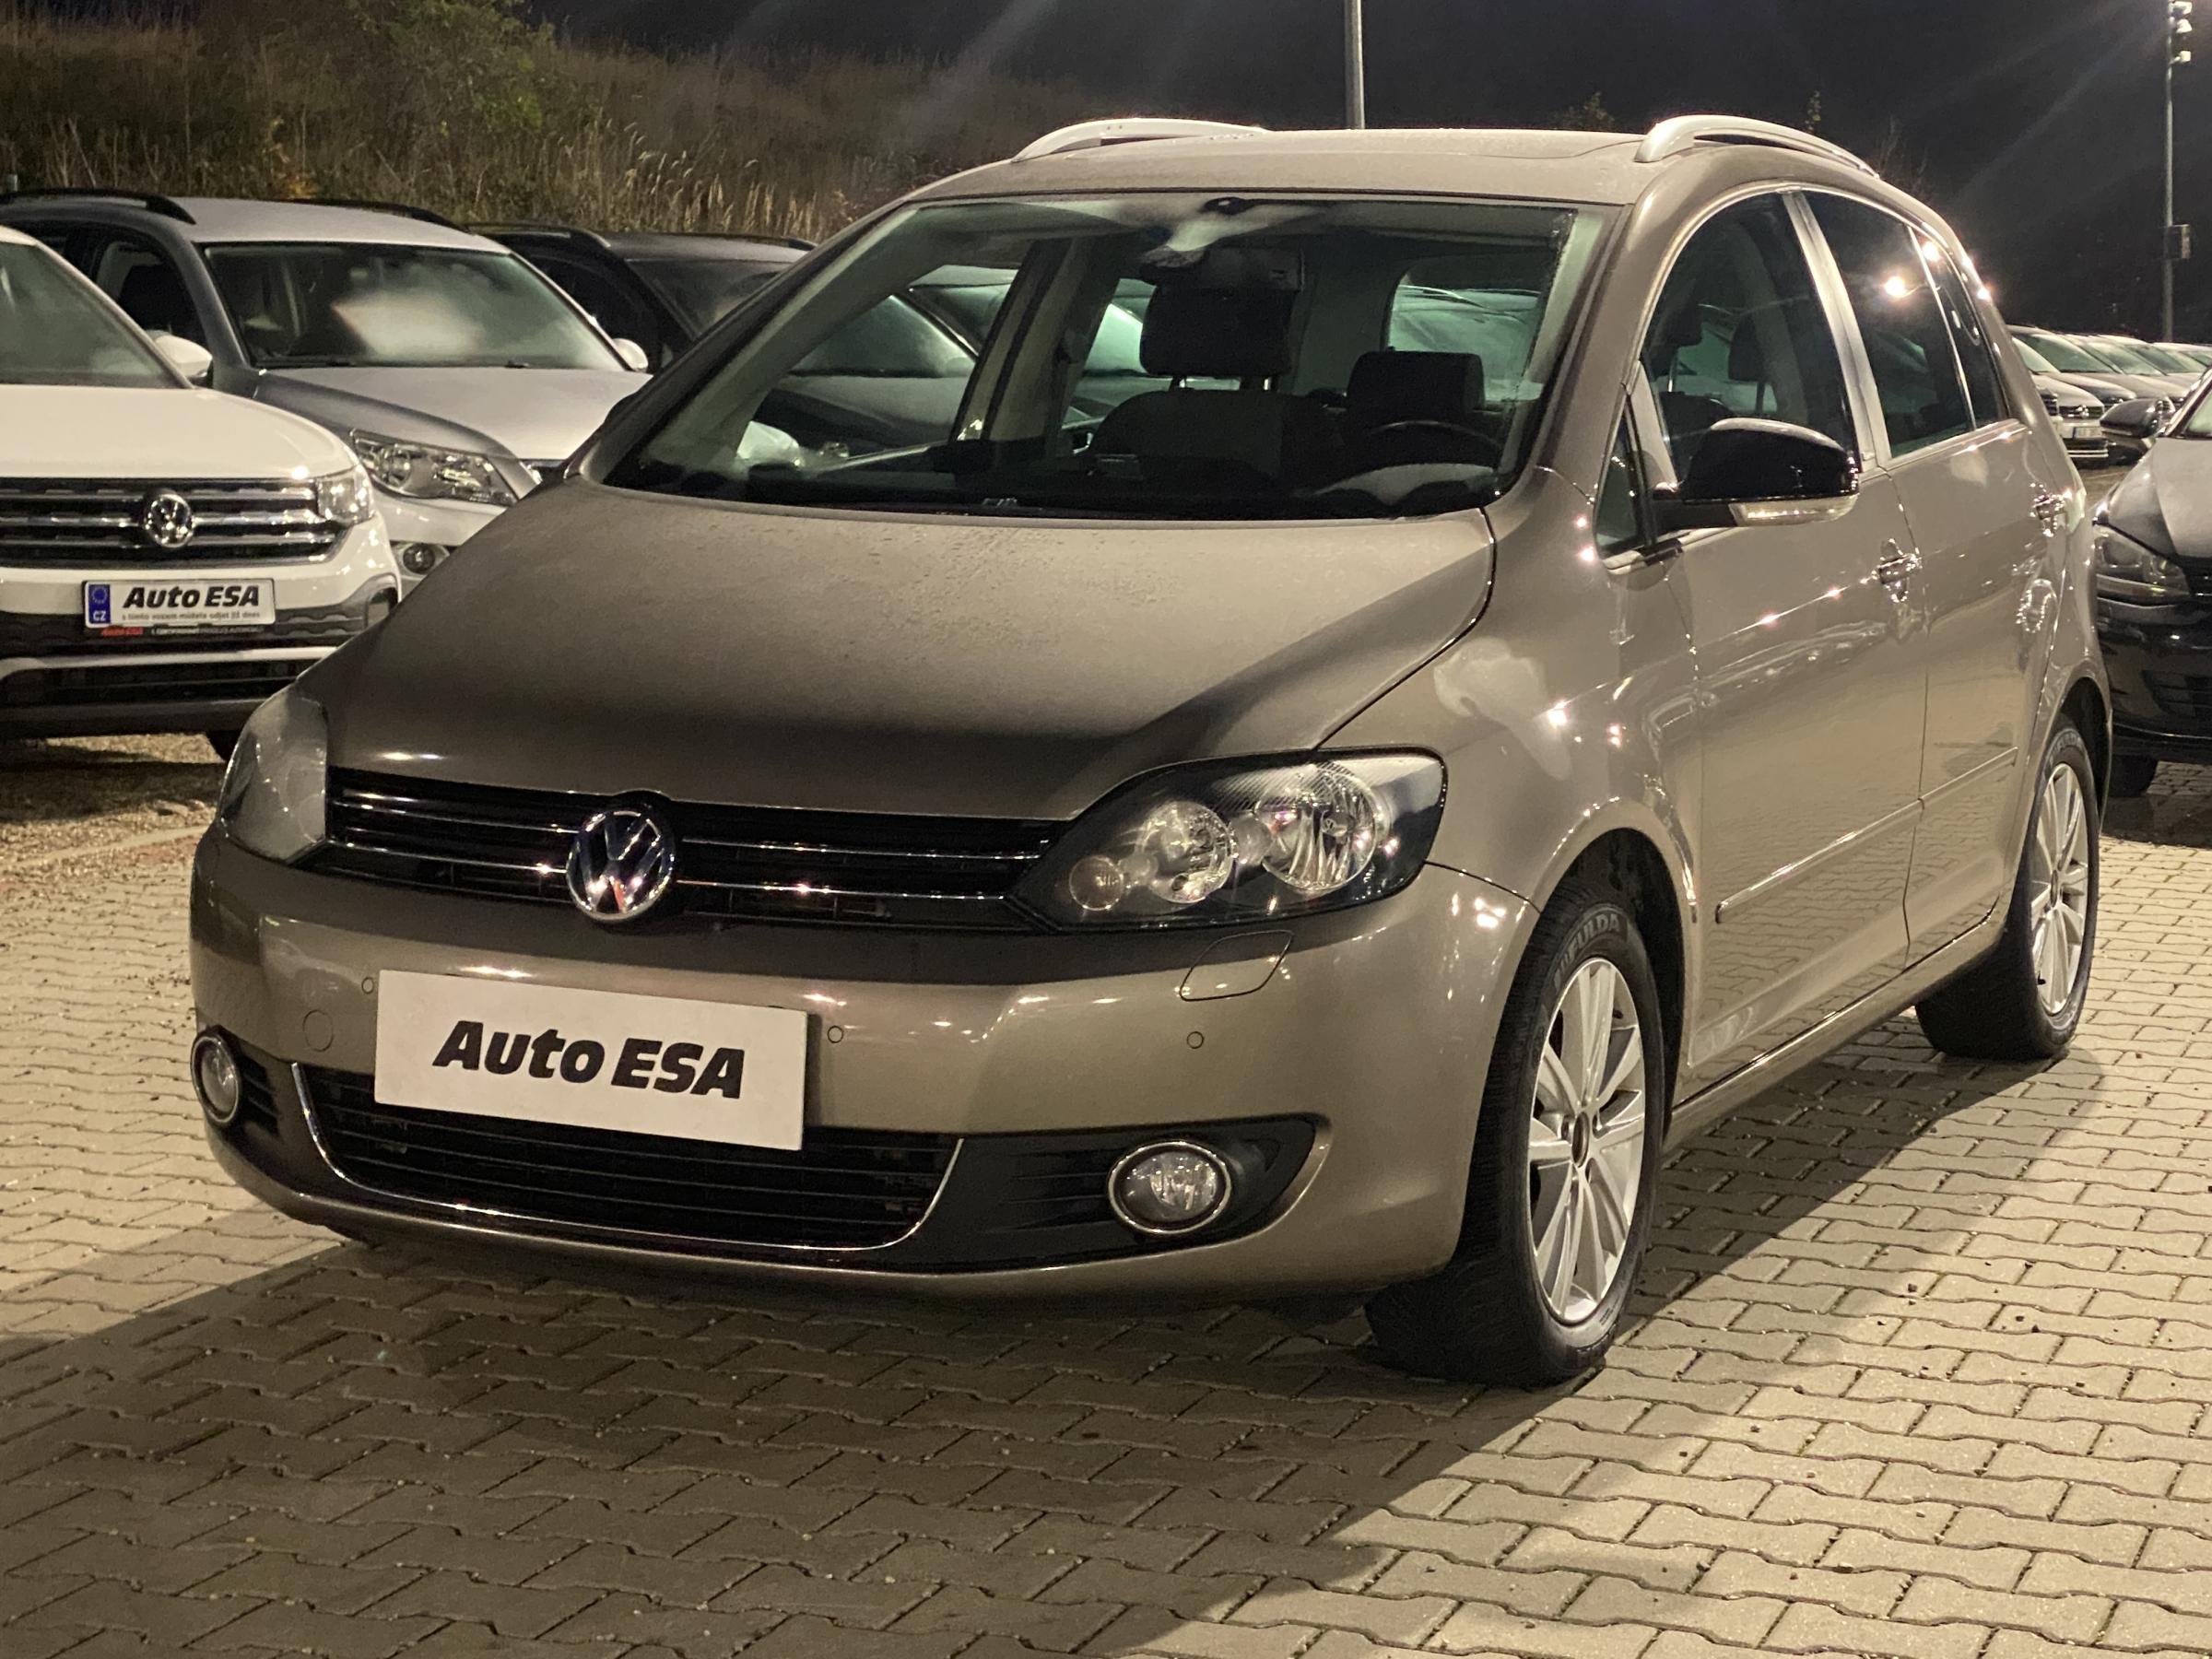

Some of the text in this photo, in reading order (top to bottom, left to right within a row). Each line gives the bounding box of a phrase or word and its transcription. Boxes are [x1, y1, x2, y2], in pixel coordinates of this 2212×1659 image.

[123, 585, 259, 608] Auto ESA
[93, 610, 107, 622] CZ
[1568, 912, 1621, 964] FULDA
[432, 1019, 746, 1100] Auto ESA
